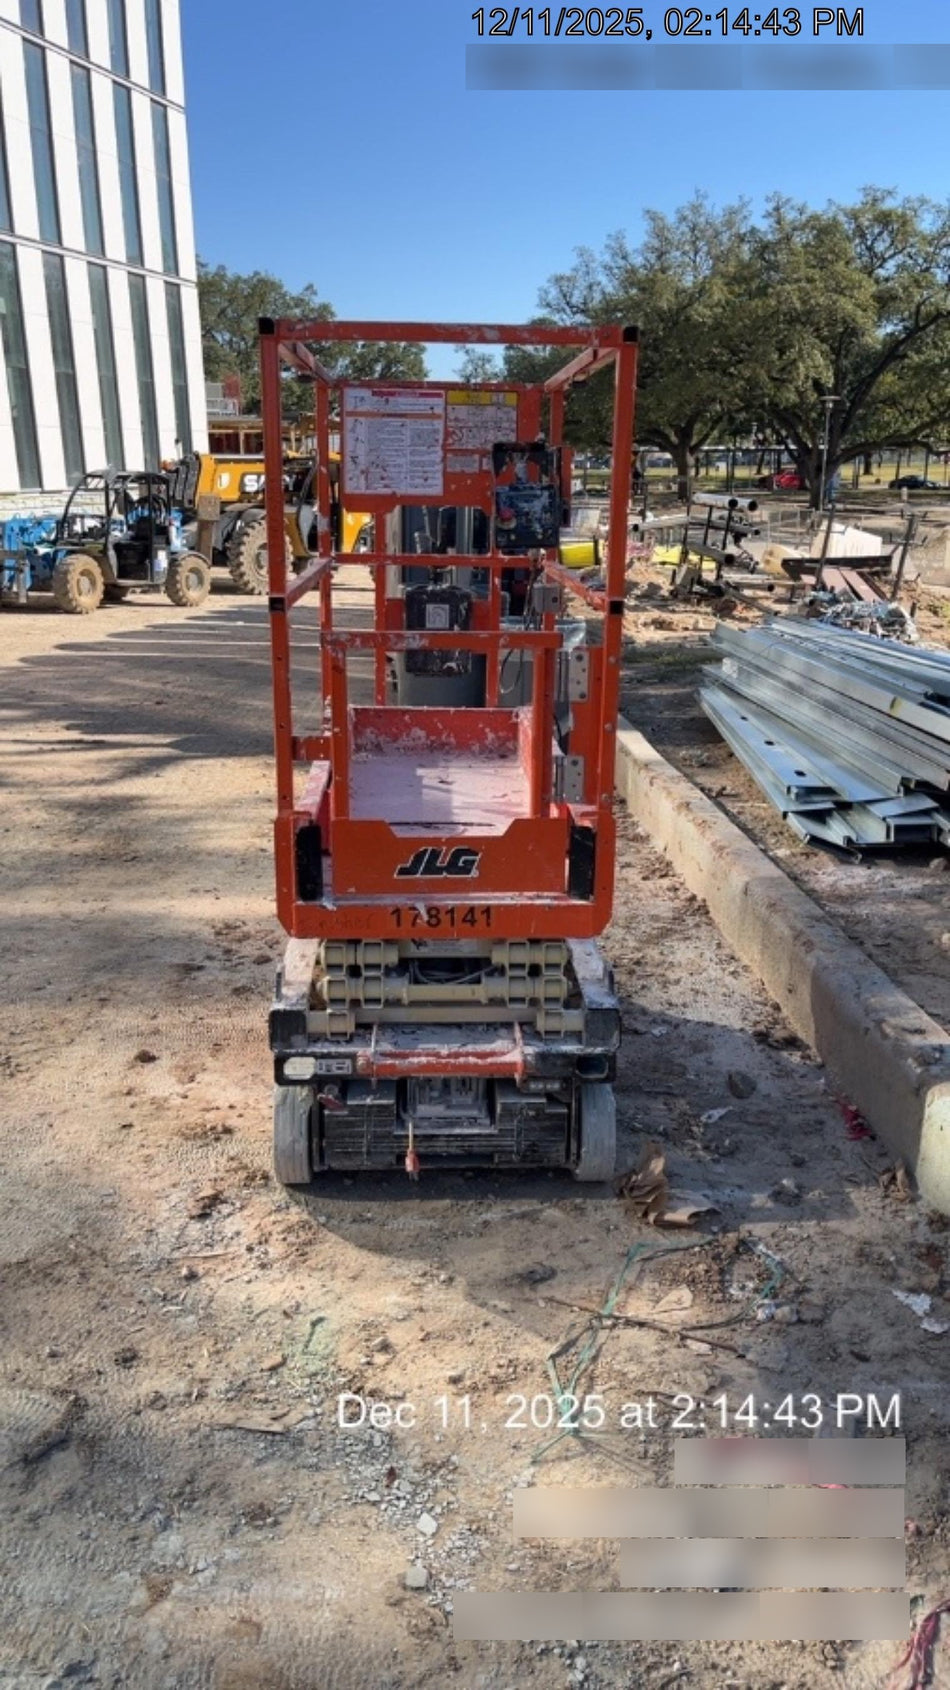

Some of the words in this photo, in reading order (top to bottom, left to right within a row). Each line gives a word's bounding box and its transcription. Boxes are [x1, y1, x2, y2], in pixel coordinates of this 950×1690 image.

[243, 474, 296, 493] SY
[393, 846, 482, 879] JLG
[390, 906, 492, 928] 178141
